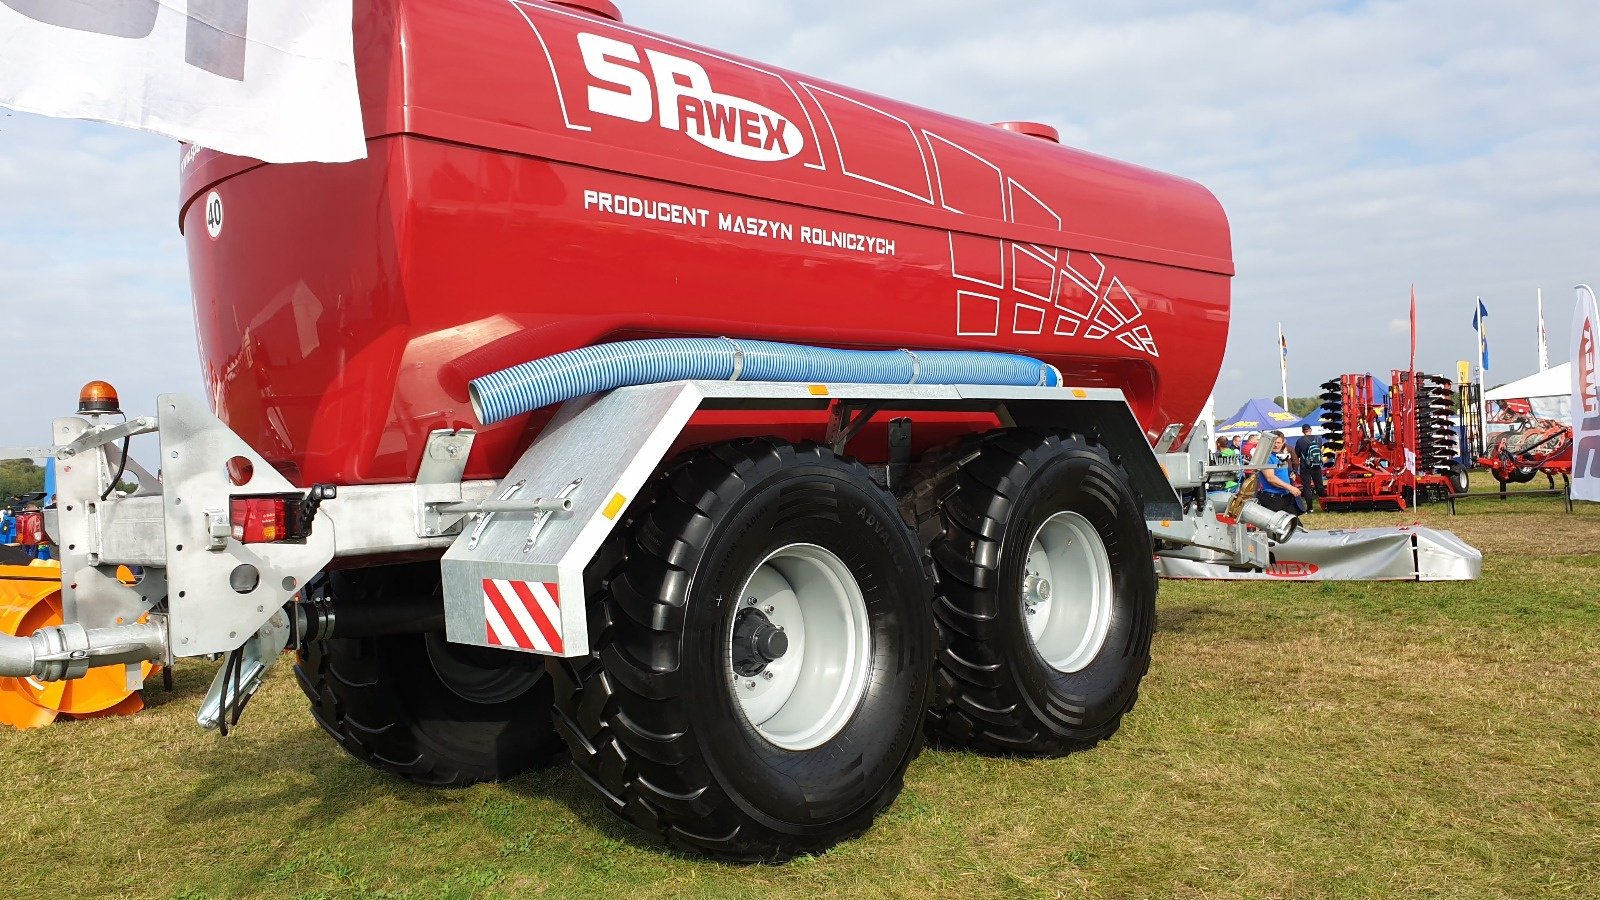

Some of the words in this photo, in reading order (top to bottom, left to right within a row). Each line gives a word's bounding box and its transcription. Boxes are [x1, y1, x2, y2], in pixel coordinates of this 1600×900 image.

[208, 199, 221, 228] 40
[584, 189, 709, 227] PRODUCENT
[718, 212, 793, 241] MASZYN
[800, 226, 896, 256] ROLNICZYCH
